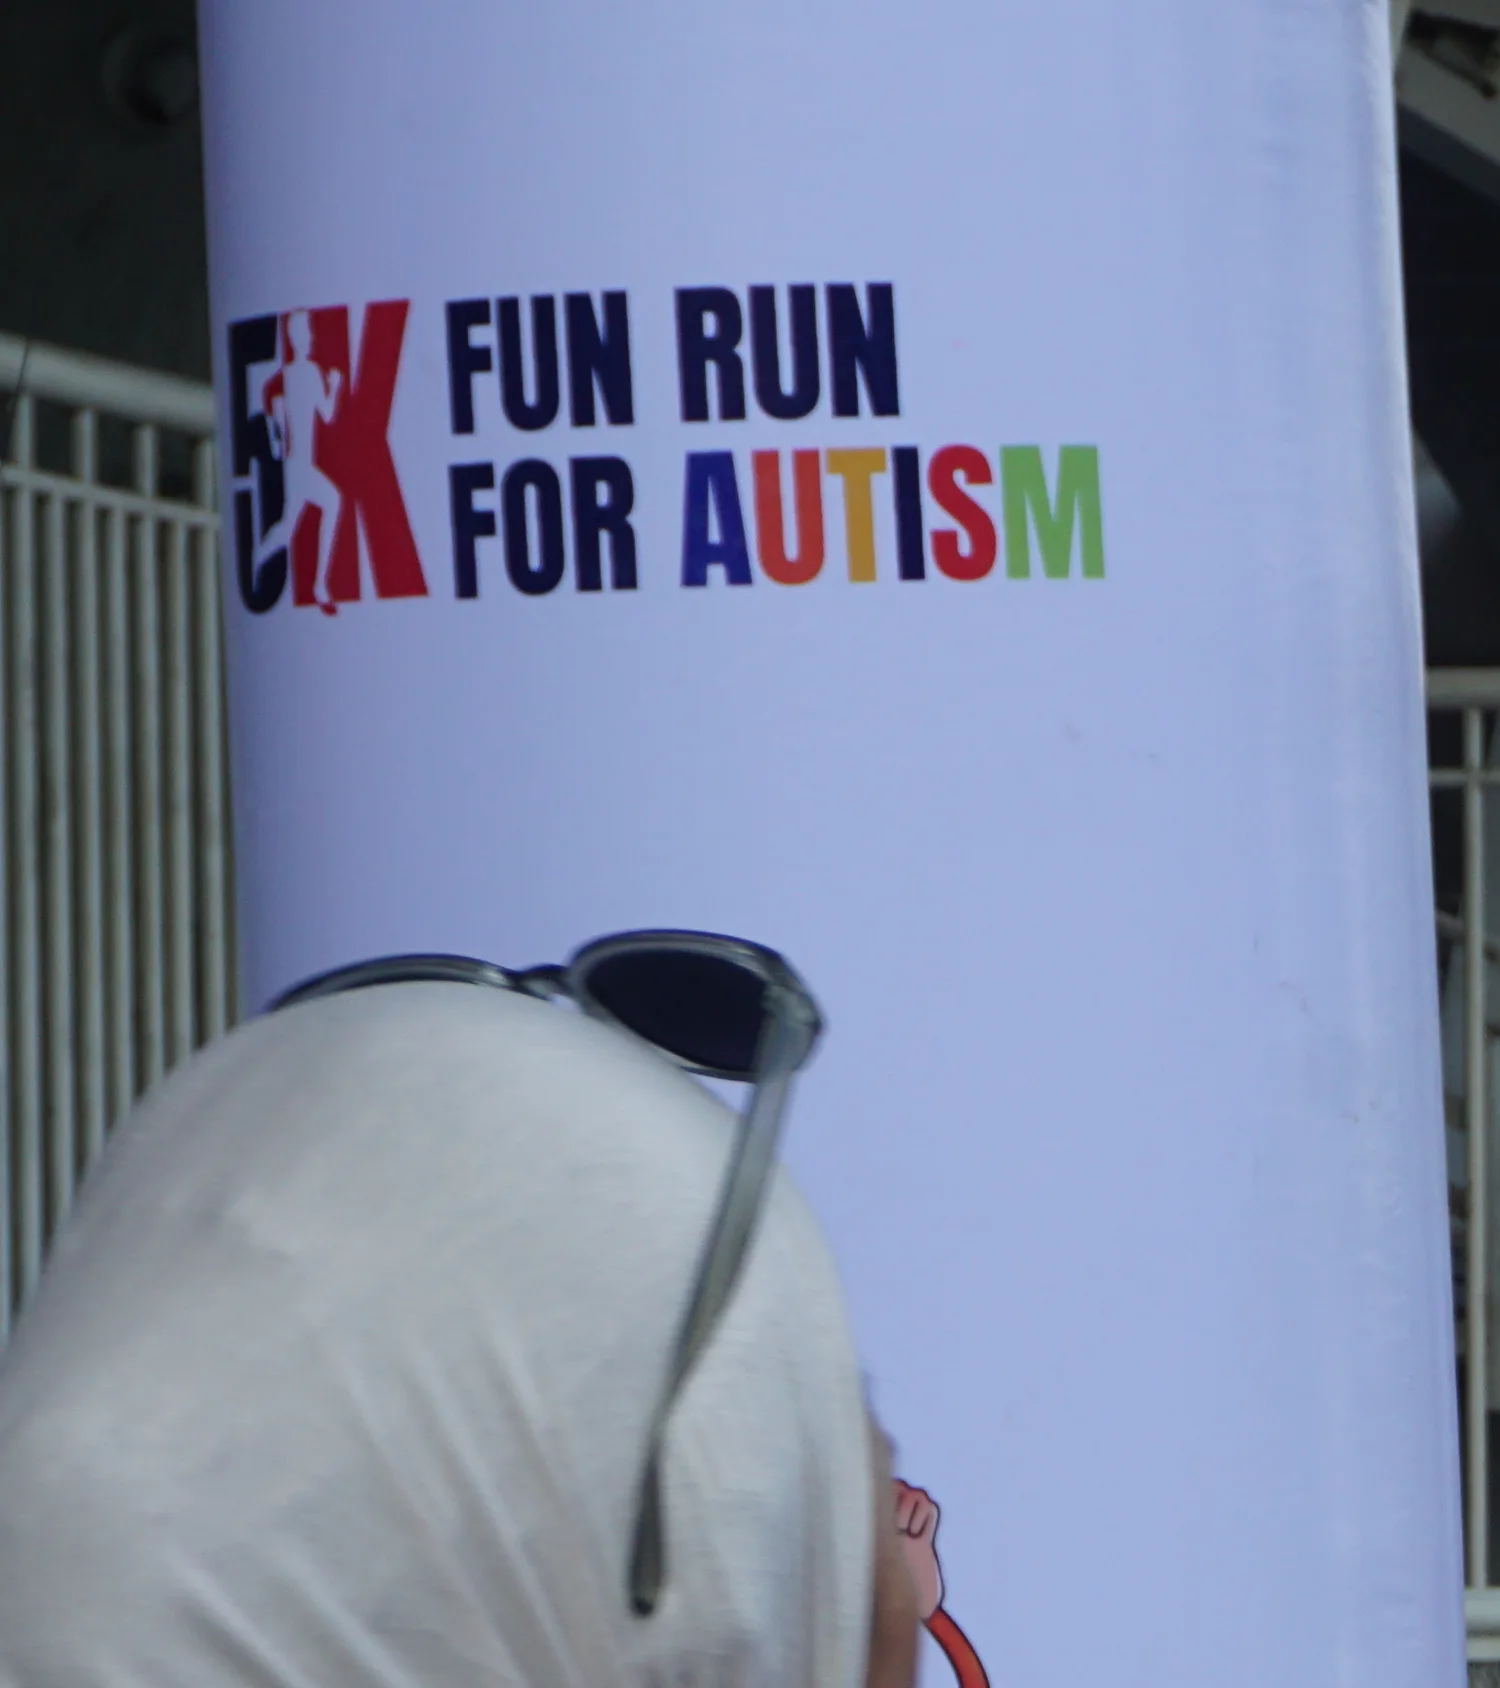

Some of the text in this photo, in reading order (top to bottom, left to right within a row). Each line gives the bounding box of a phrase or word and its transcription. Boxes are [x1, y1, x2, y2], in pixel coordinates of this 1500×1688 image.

[444, 282, 902, 436] FUN RUN
[447, 444, 1107, 600] FOR AUTISM
